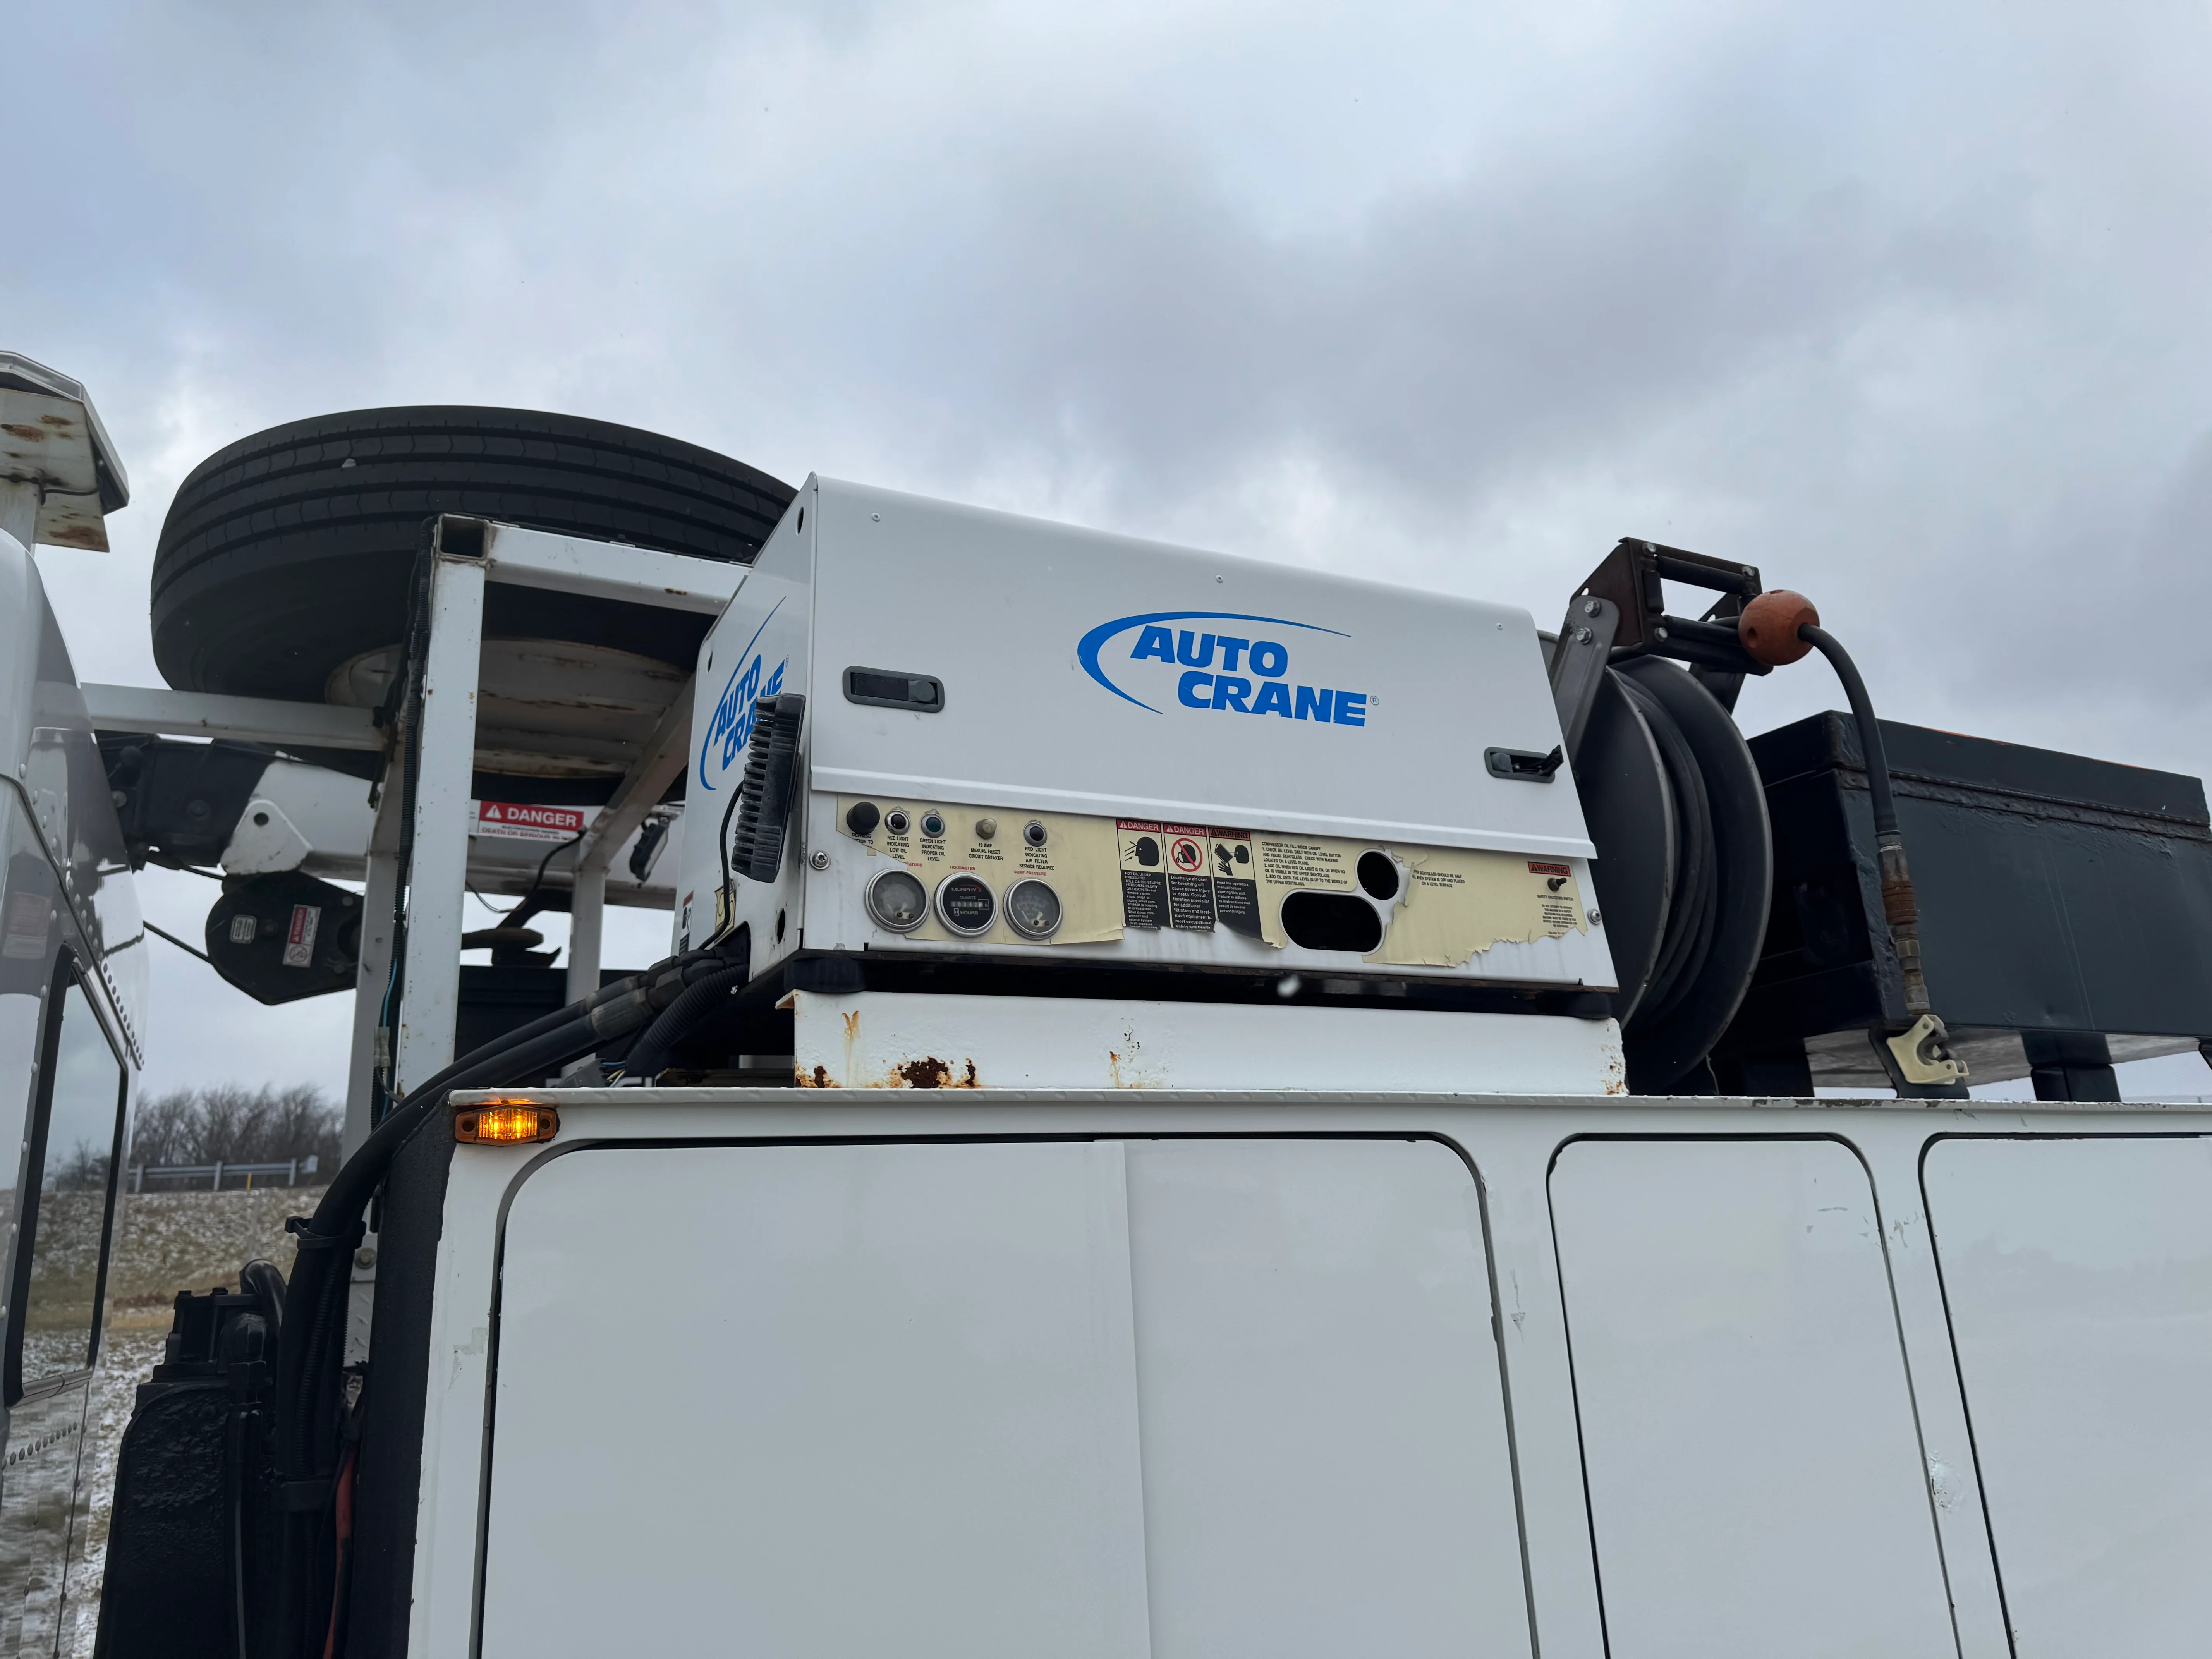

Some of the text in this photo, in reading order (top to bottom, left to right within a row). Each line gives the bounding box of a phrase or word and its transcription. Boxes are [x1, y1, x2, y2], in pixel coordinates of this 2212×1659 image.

[1130, 625, 1287, 677] AUTO
[713, 654, 761, 747] AUTO
[1178, 671, 1366, 727] CRANE
[508, 807, 577, 826] DANGER
[1128, 822, 1158, 831] DANGER
[1174, 826, 1204, 835] DANGER
[1537, 865, 1568, 874] WARNING
